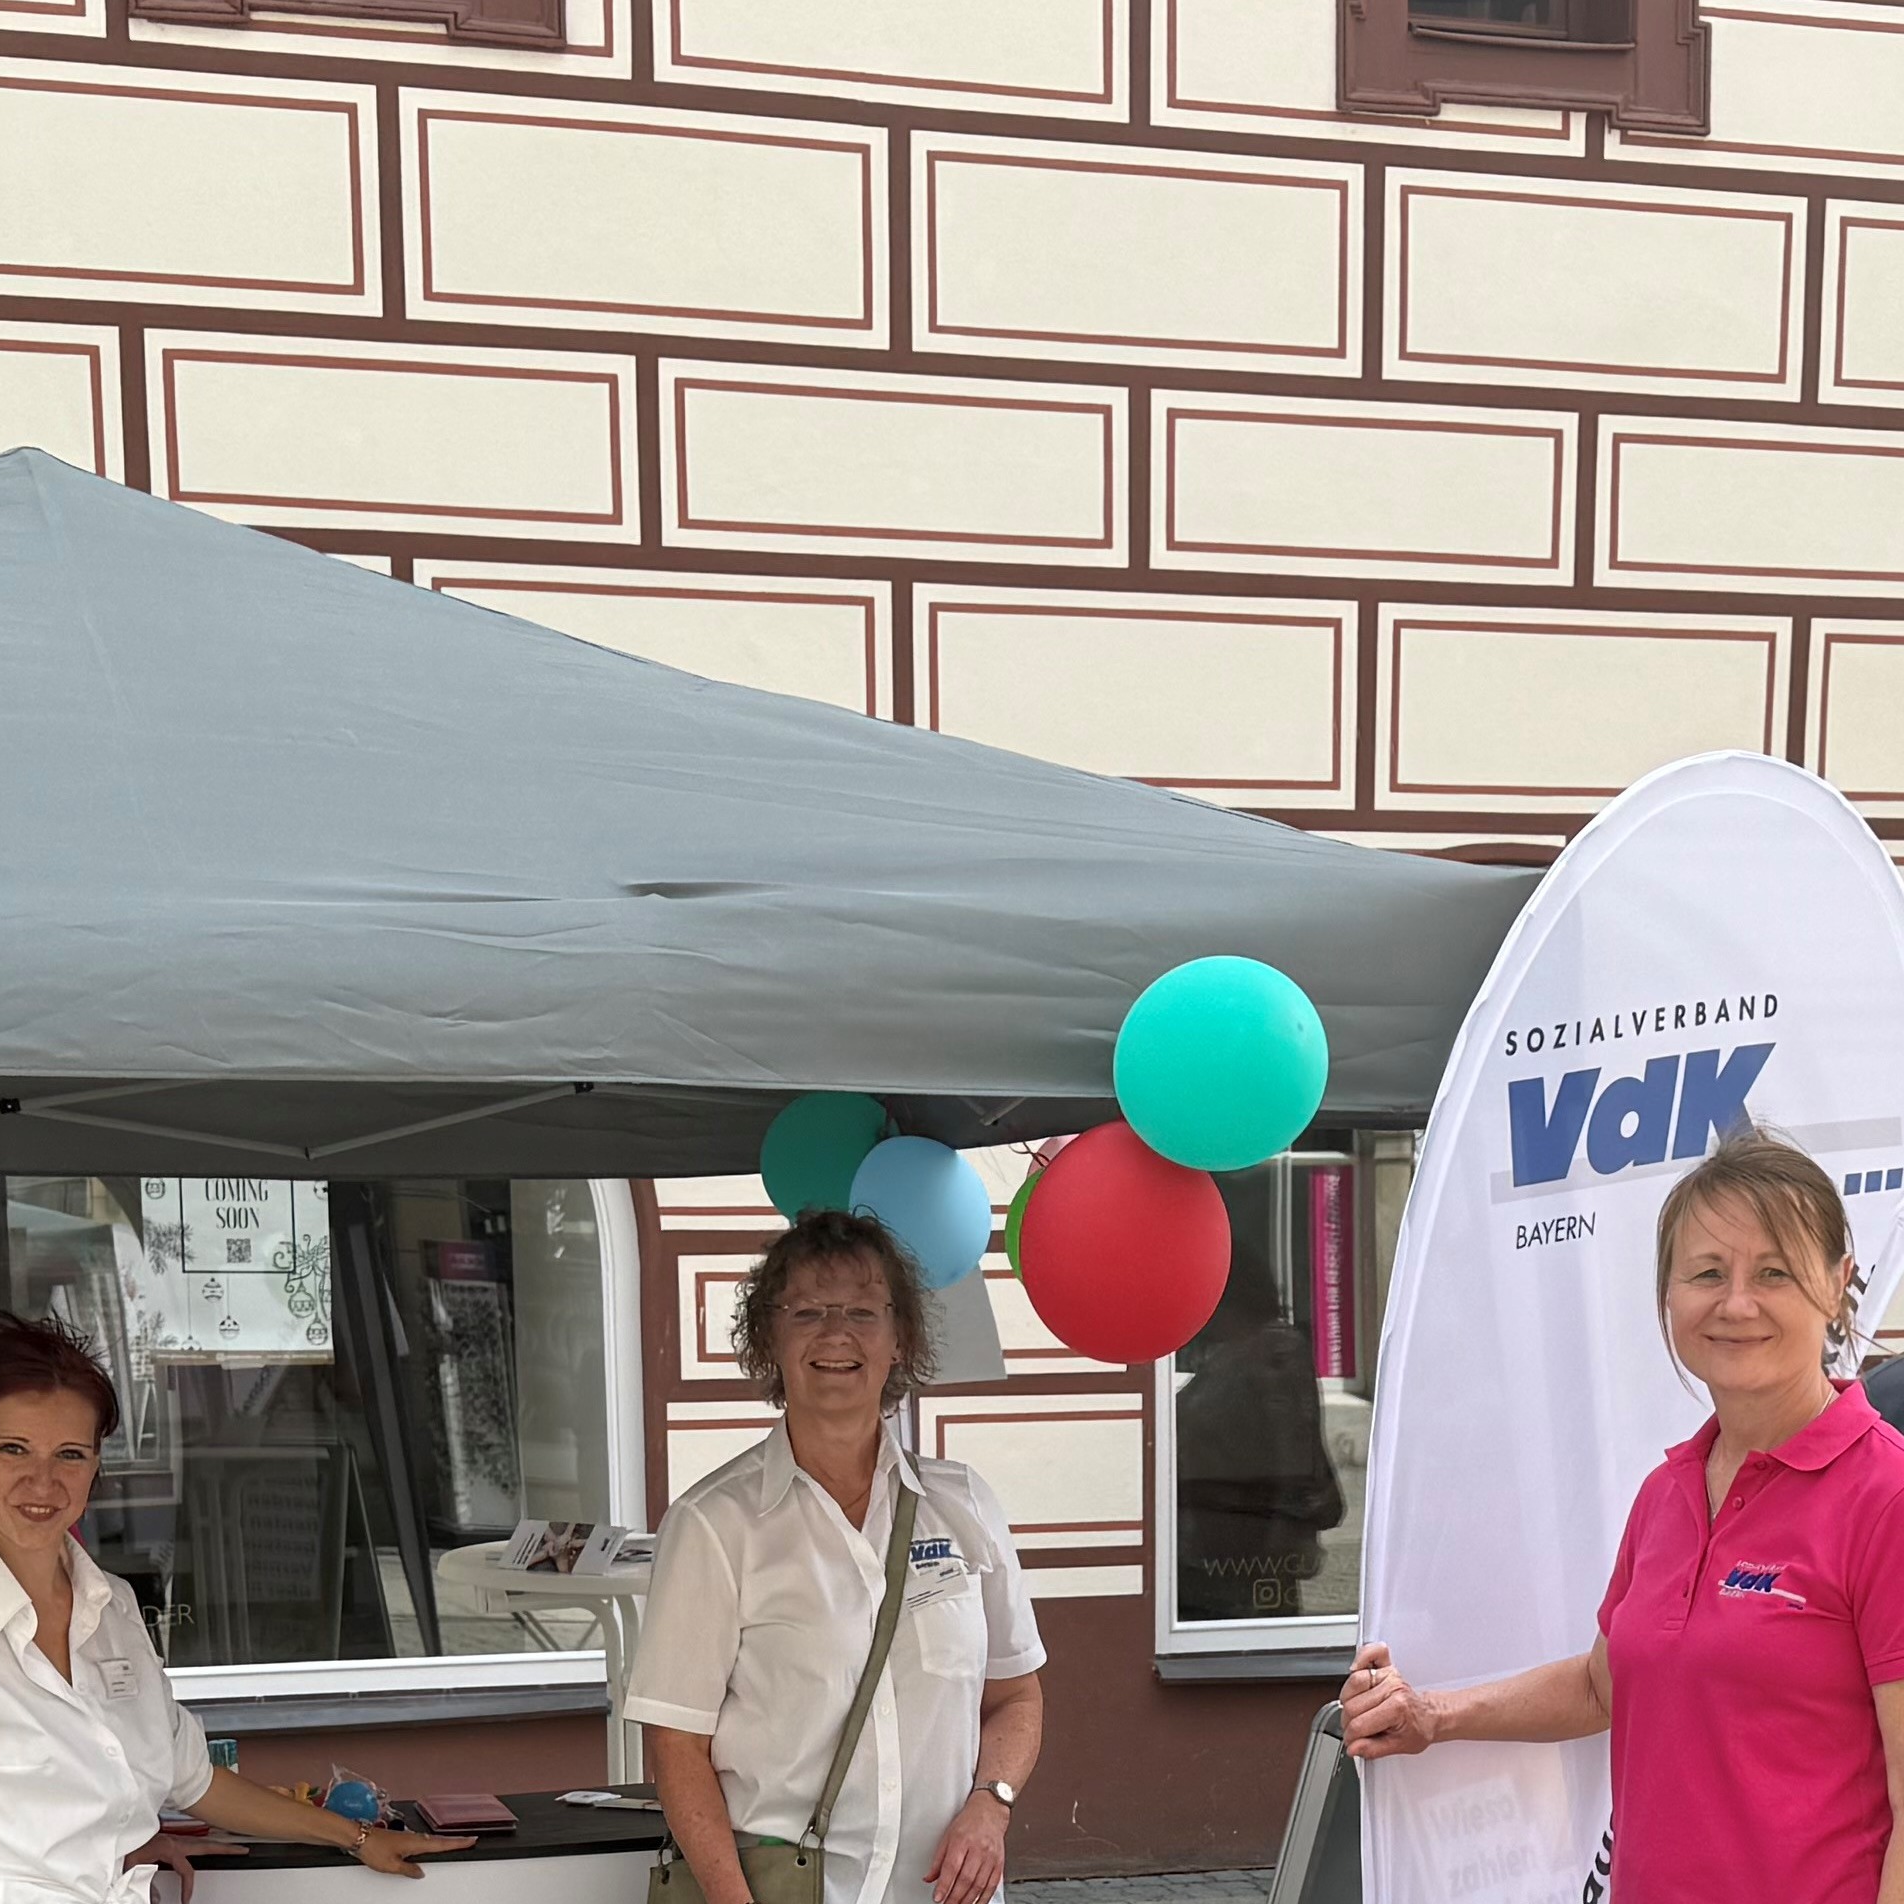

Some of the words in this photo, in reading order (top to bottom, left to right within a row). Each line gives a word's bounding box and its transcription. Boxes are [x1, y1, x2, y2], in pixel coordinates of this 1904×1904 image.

[1504, 993, 1779, 1057] SOZIALVERBAND
[1507, 1042, 1777, 1188] VdK
[205, 1179, 268, 1202] COMING
[216, 1207, 260, 1230] SOON
[1515, 1212, 1596, 1249] BAYERN
[1725, 1567, 1782, 1593] VdK
